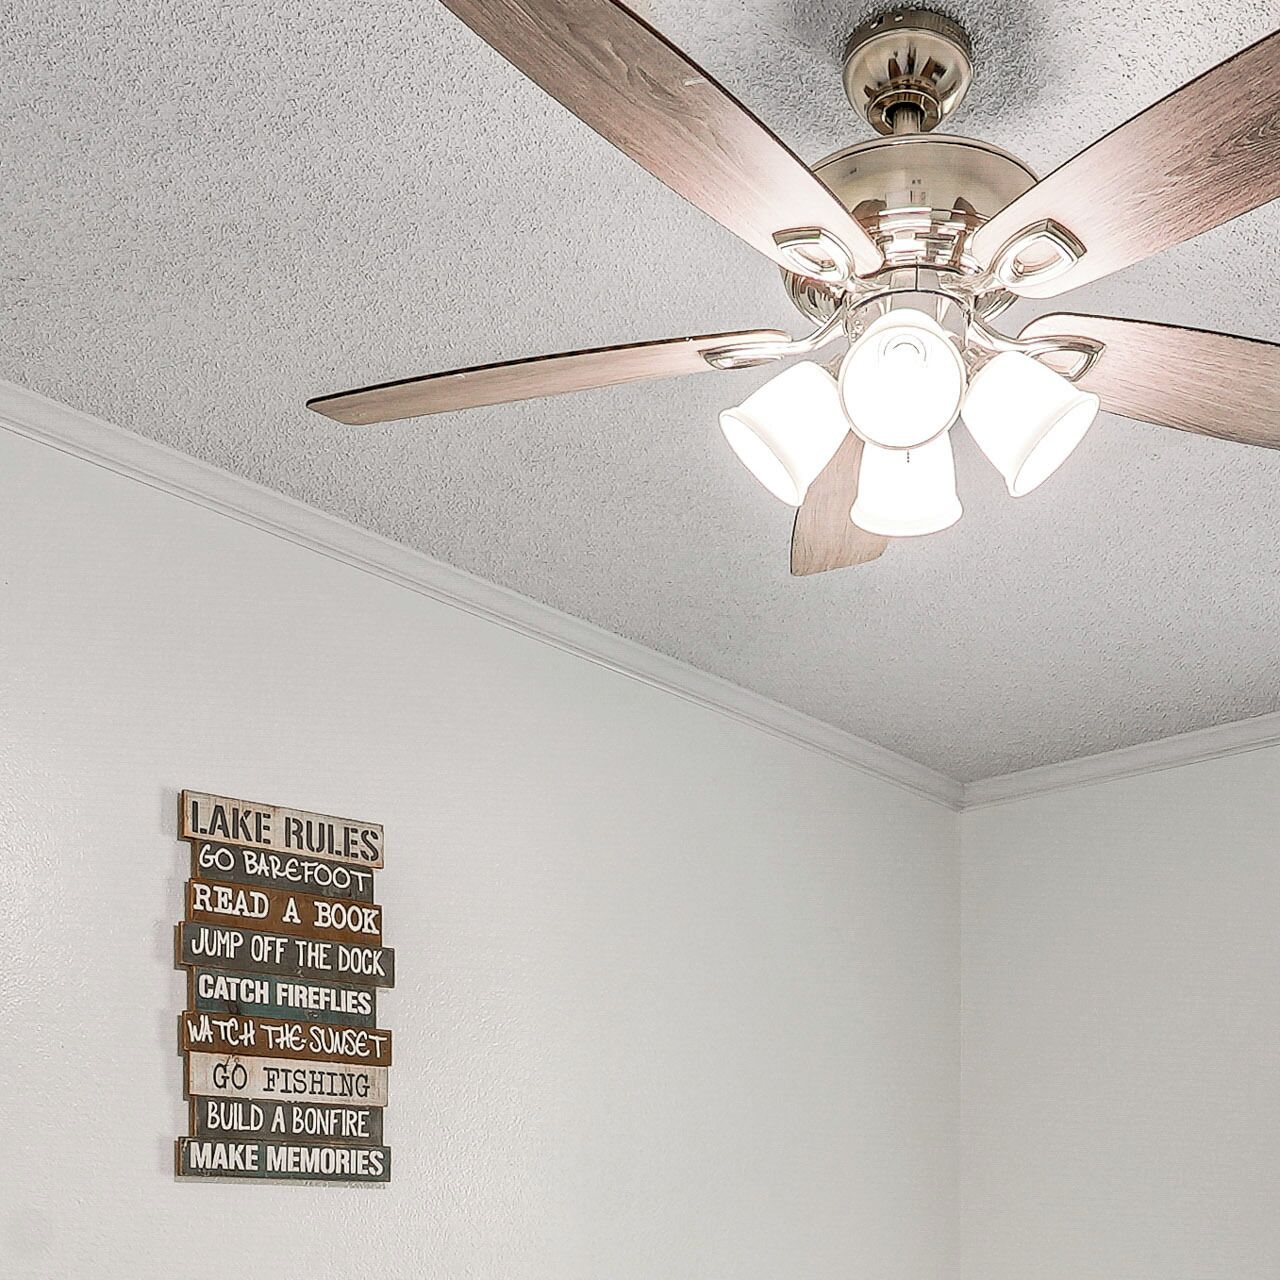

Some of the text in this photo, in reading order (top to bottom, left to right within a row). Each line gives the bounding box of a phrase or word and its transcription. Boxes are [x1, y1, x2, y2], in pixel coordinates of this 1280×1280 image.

[191, 800, 380, 862] LAKE RULES
[199, 844, 372, 892] GO BAREFOOT
[192, 884, 380, 935] READ A BOOK
[191, 928, 386, 977] JUMP OFF THE DOCK
[198, 974, 372, 1016] CATCH FIREFLIES
[187, 1014, 388, 1058] WATCH THE SUNSET
[213, 1062, 370, 1098] GO FISHING
[207, 1101, 370, 1138] BUILD A BONFIRE
[190, 1143, 384, 1176] MAKE MEMORIES
